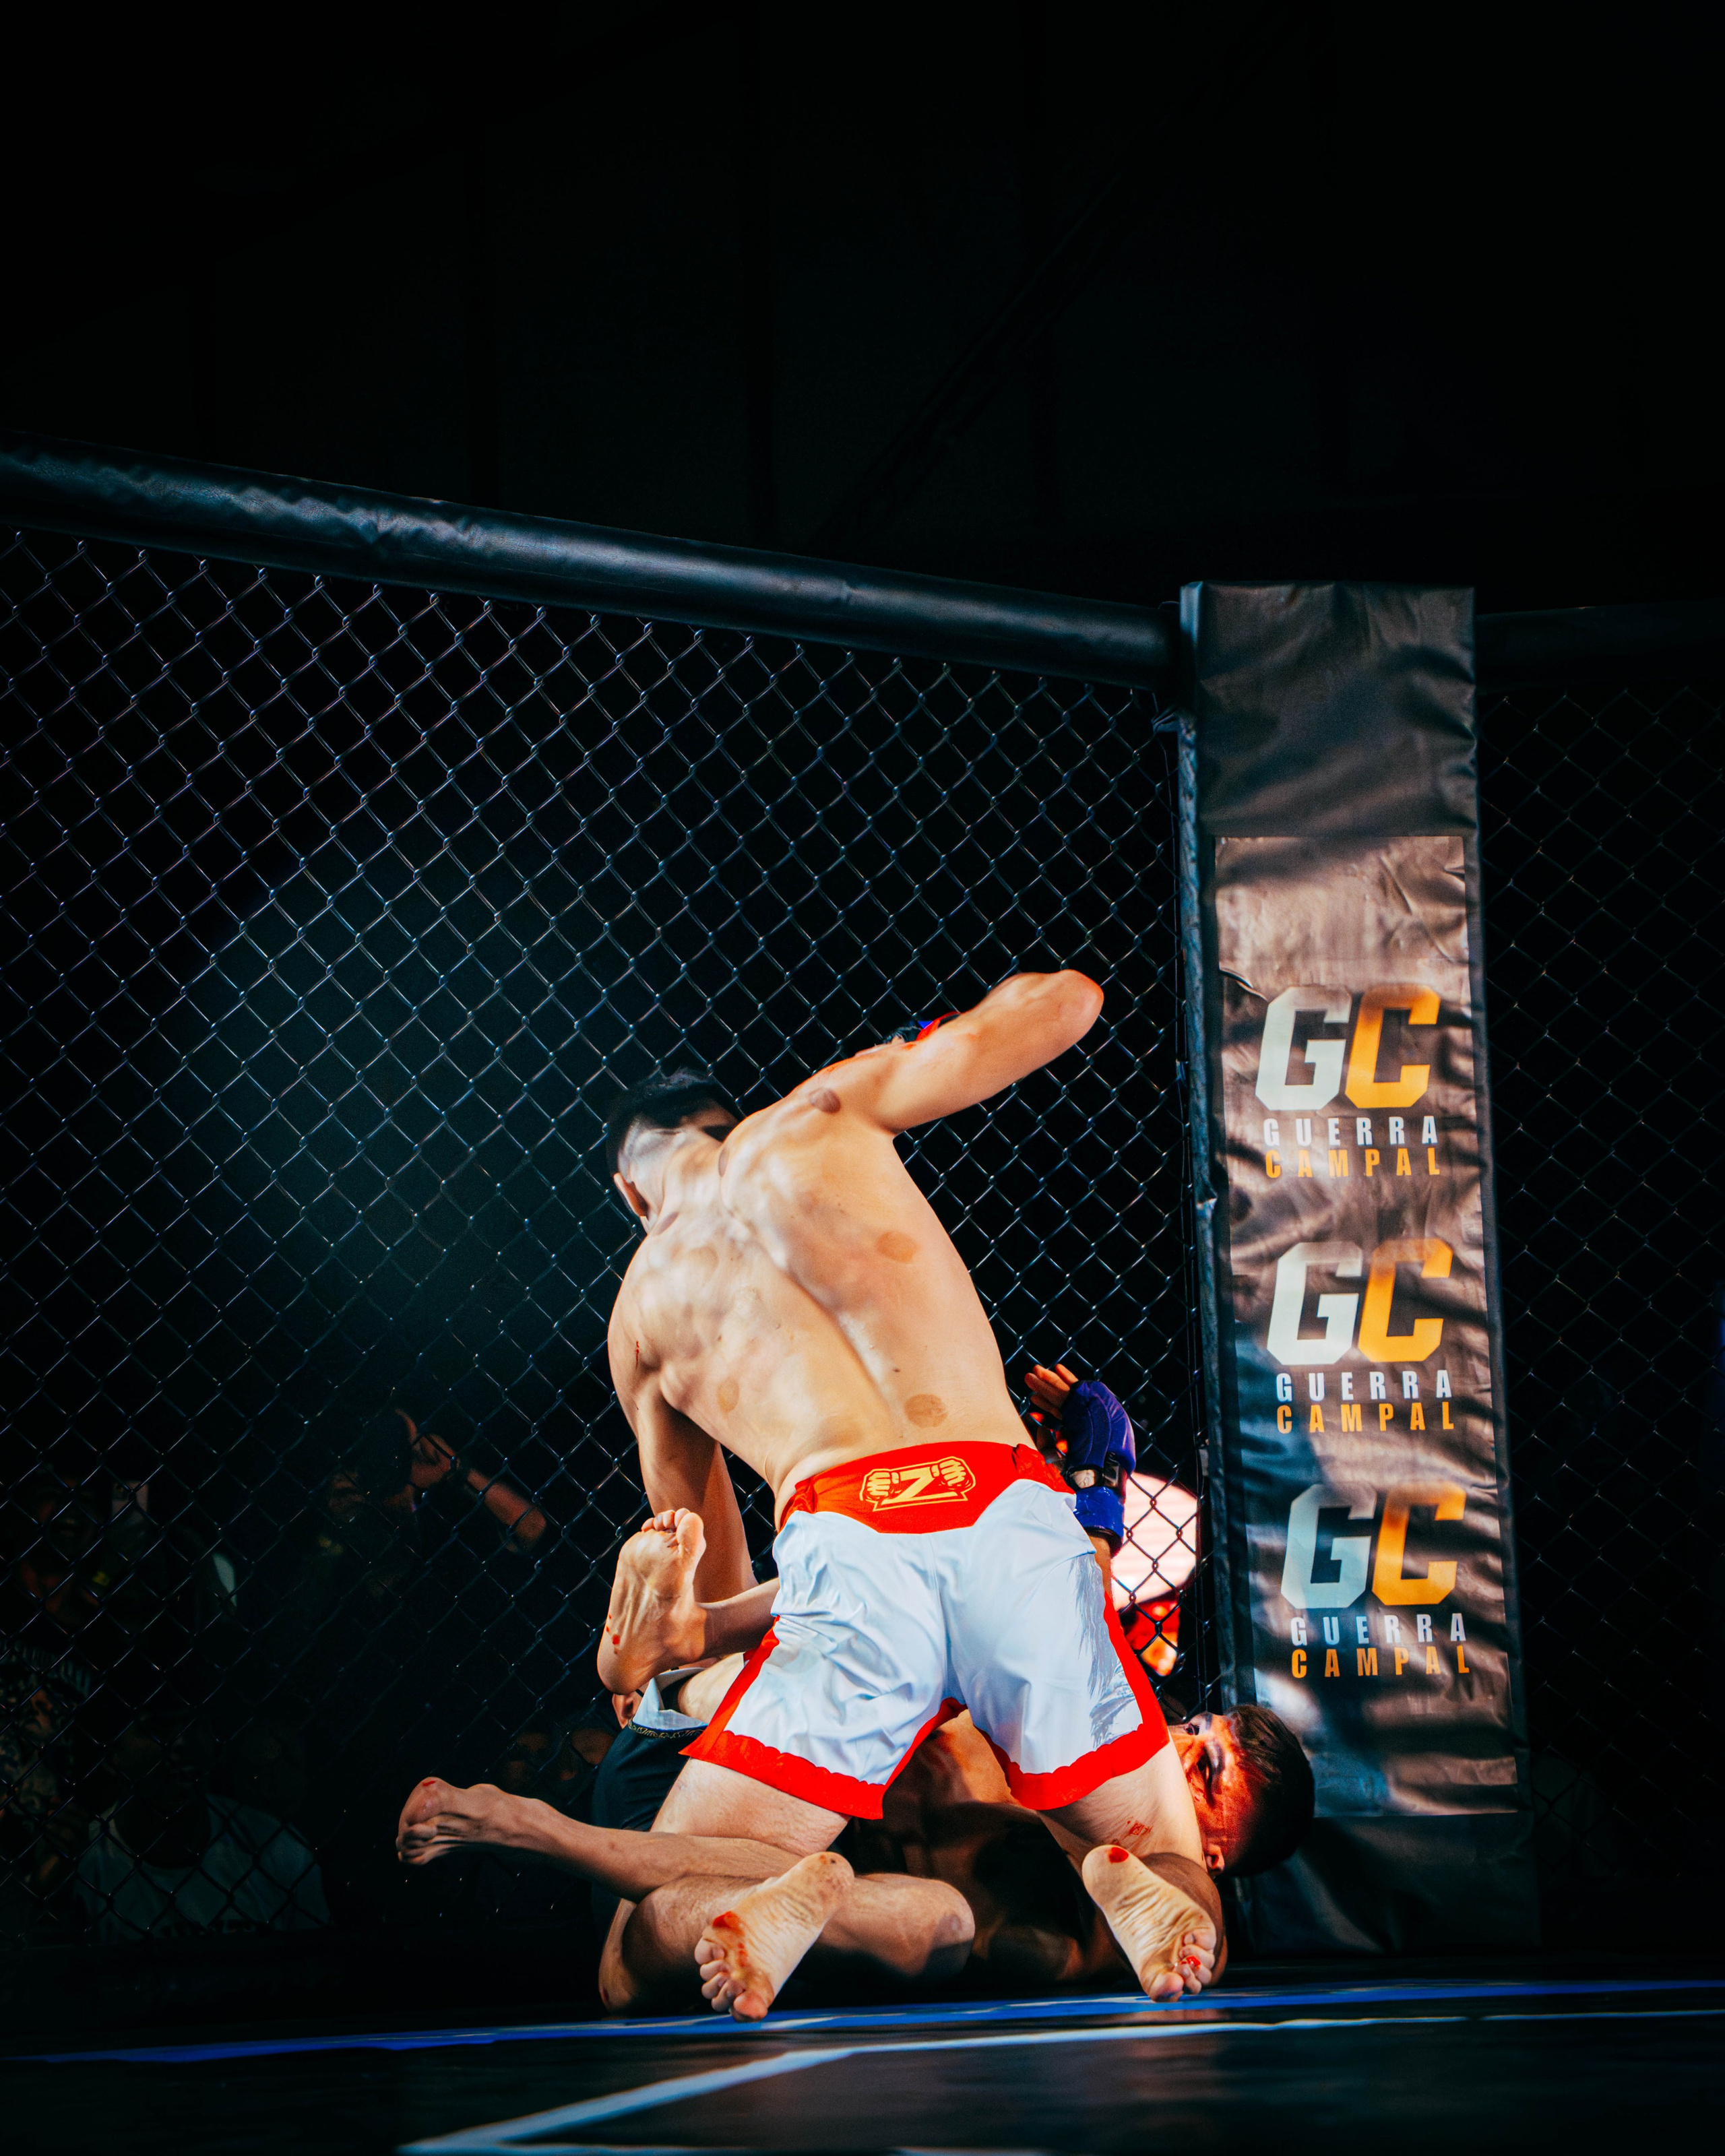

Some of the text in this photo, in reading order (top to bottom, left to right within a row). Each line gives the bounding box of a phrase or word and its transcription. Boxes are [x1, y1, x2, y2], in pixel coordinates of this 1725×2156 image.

[1255, 984, 1441, 1110] GC
[1263, 1116, 1438, 1146] GUERRA
[1266, 1147, 1440, 1178] CAMPAL
[1267, 1239, 1453, 1365] GC
[1276, 1370, 1452, 1402] GUERRA
[1277, 1401, 1454, 1434] CAMPAL
[1281, 1483, 1466, 1609] GC
[1290, 1613, 1466, 1646] GUERRA
[1292, 1645, 1470, 1678] CAMPAL
